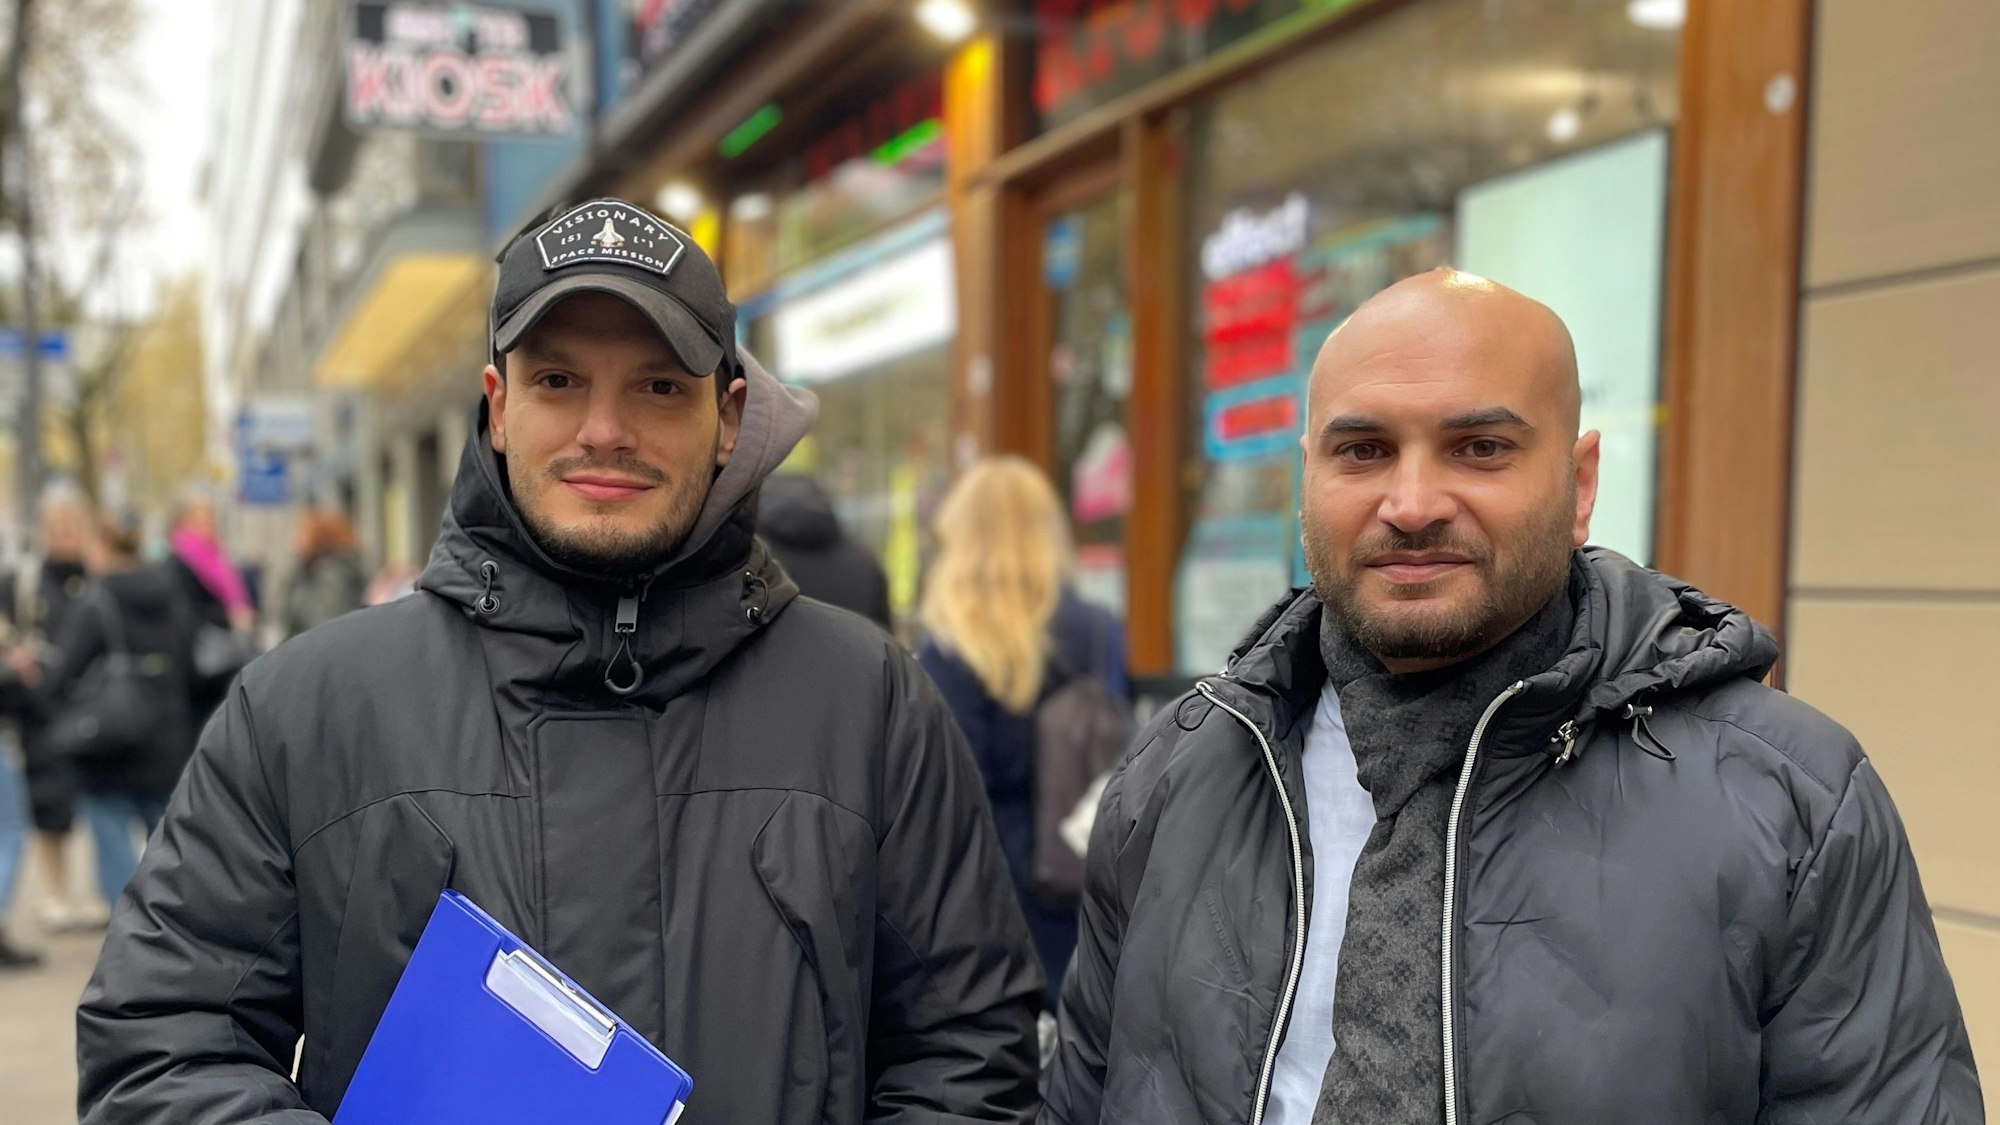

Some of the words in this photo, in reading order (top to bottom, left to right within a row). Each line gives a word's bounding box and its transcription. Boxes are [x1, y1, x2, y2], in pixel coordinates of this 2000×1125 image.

[350, 50, 570, 132] KIOSK
[552, 209, 669, 241] VISIONARY
[551, 248, 595, 264] SPACE
[601, 248, 664, 268] MISSION
